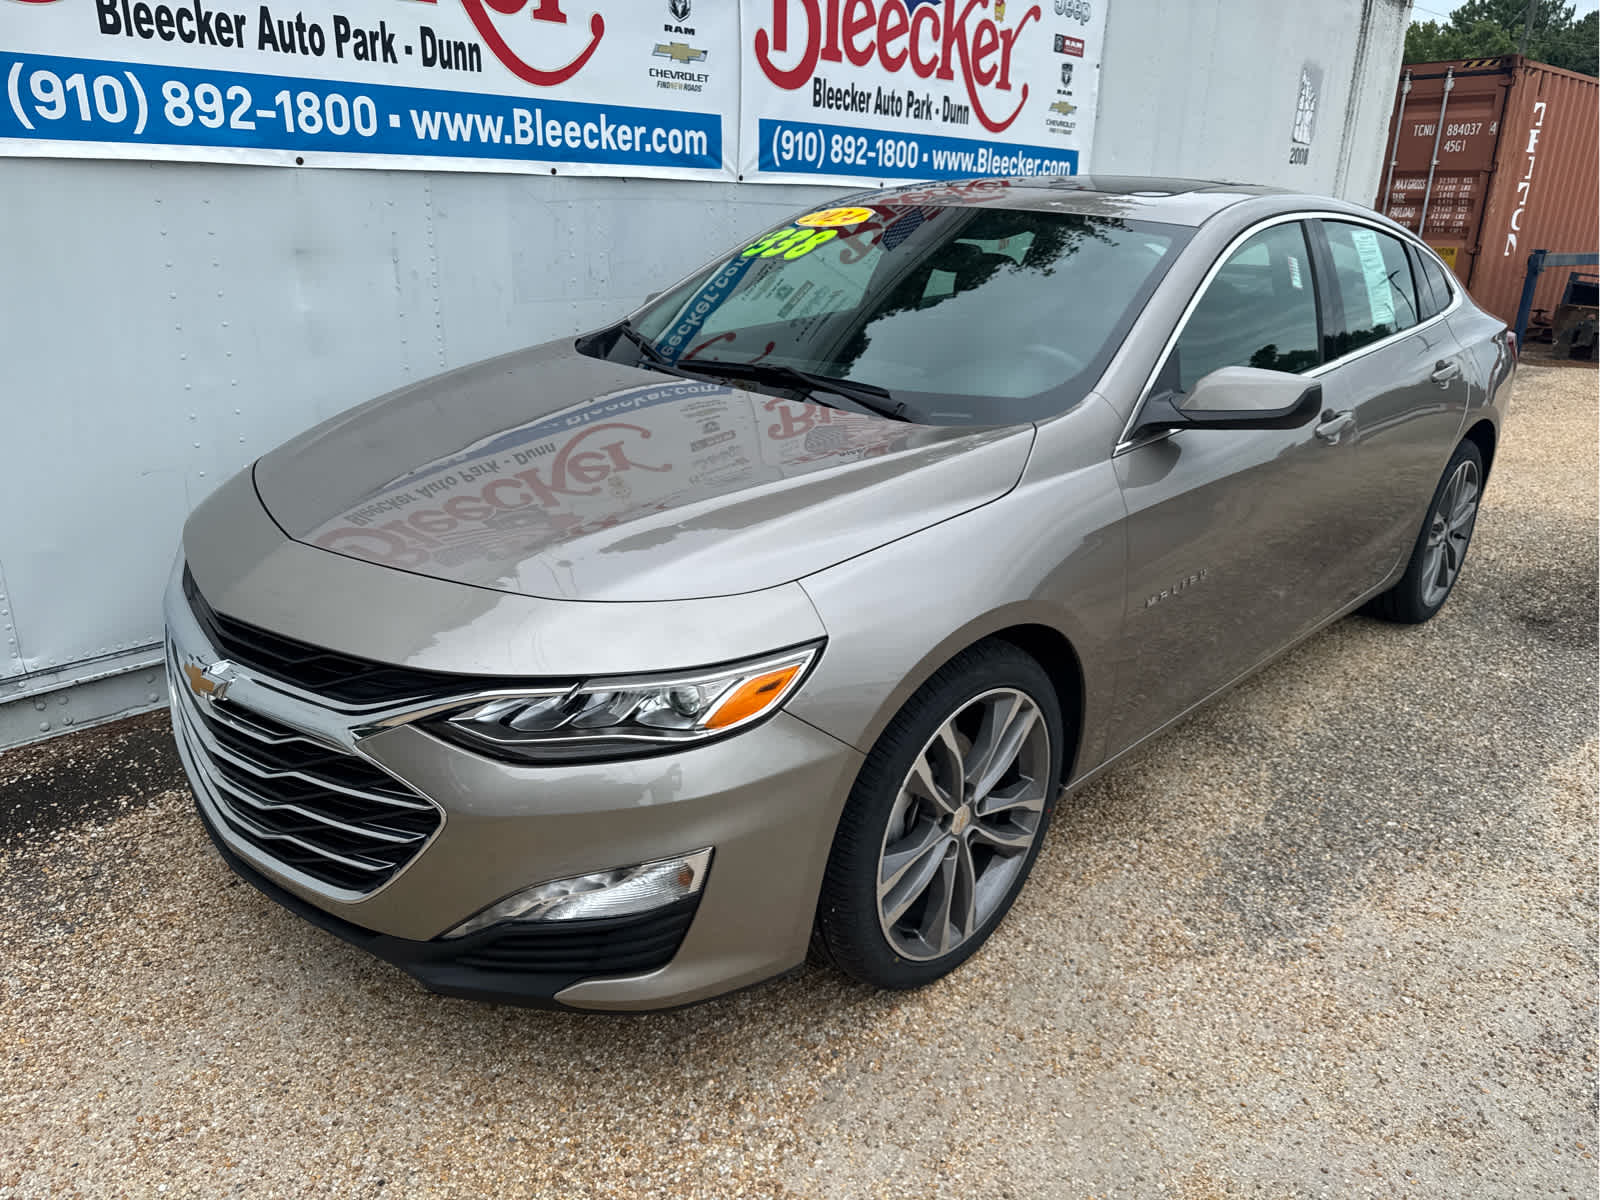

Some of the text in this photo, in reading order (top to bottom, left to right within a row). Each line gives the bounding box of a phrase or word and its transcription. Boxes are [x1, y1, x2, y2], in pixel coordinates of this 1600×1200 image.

[1054, 0, 1091, 26] Jeep
[96, 0, 247, 49] Bleecker
[258, 5, 326, 57] Auto
[332, 14, 398, 64] Park
[419, 25, 482, 72] Dunn
[664, 24, 695, 36] RAM
[1065, 40, 1083, 49] RAM
[649, 67, 710, 83] CHEVROLET
[1056, 89, 1073, 97] RAM
[8, 61, 708, 156] (910) 892-1800 www.Bleecker.com
[812, 77, 872, 115] Bleecker
[874, 86, 903, 119] Auto
[905, 98, 933, 122] Park
[942, 100, 969, 126] Dunn
[1413, 124, 1436, 137] TCNU
[1446, 122, 1483, 137] 884037
[772, 125, 1071, 176] (910) 892-1800 www.Bleecker.com
[1443, 139, 1466, 153] 45G1
